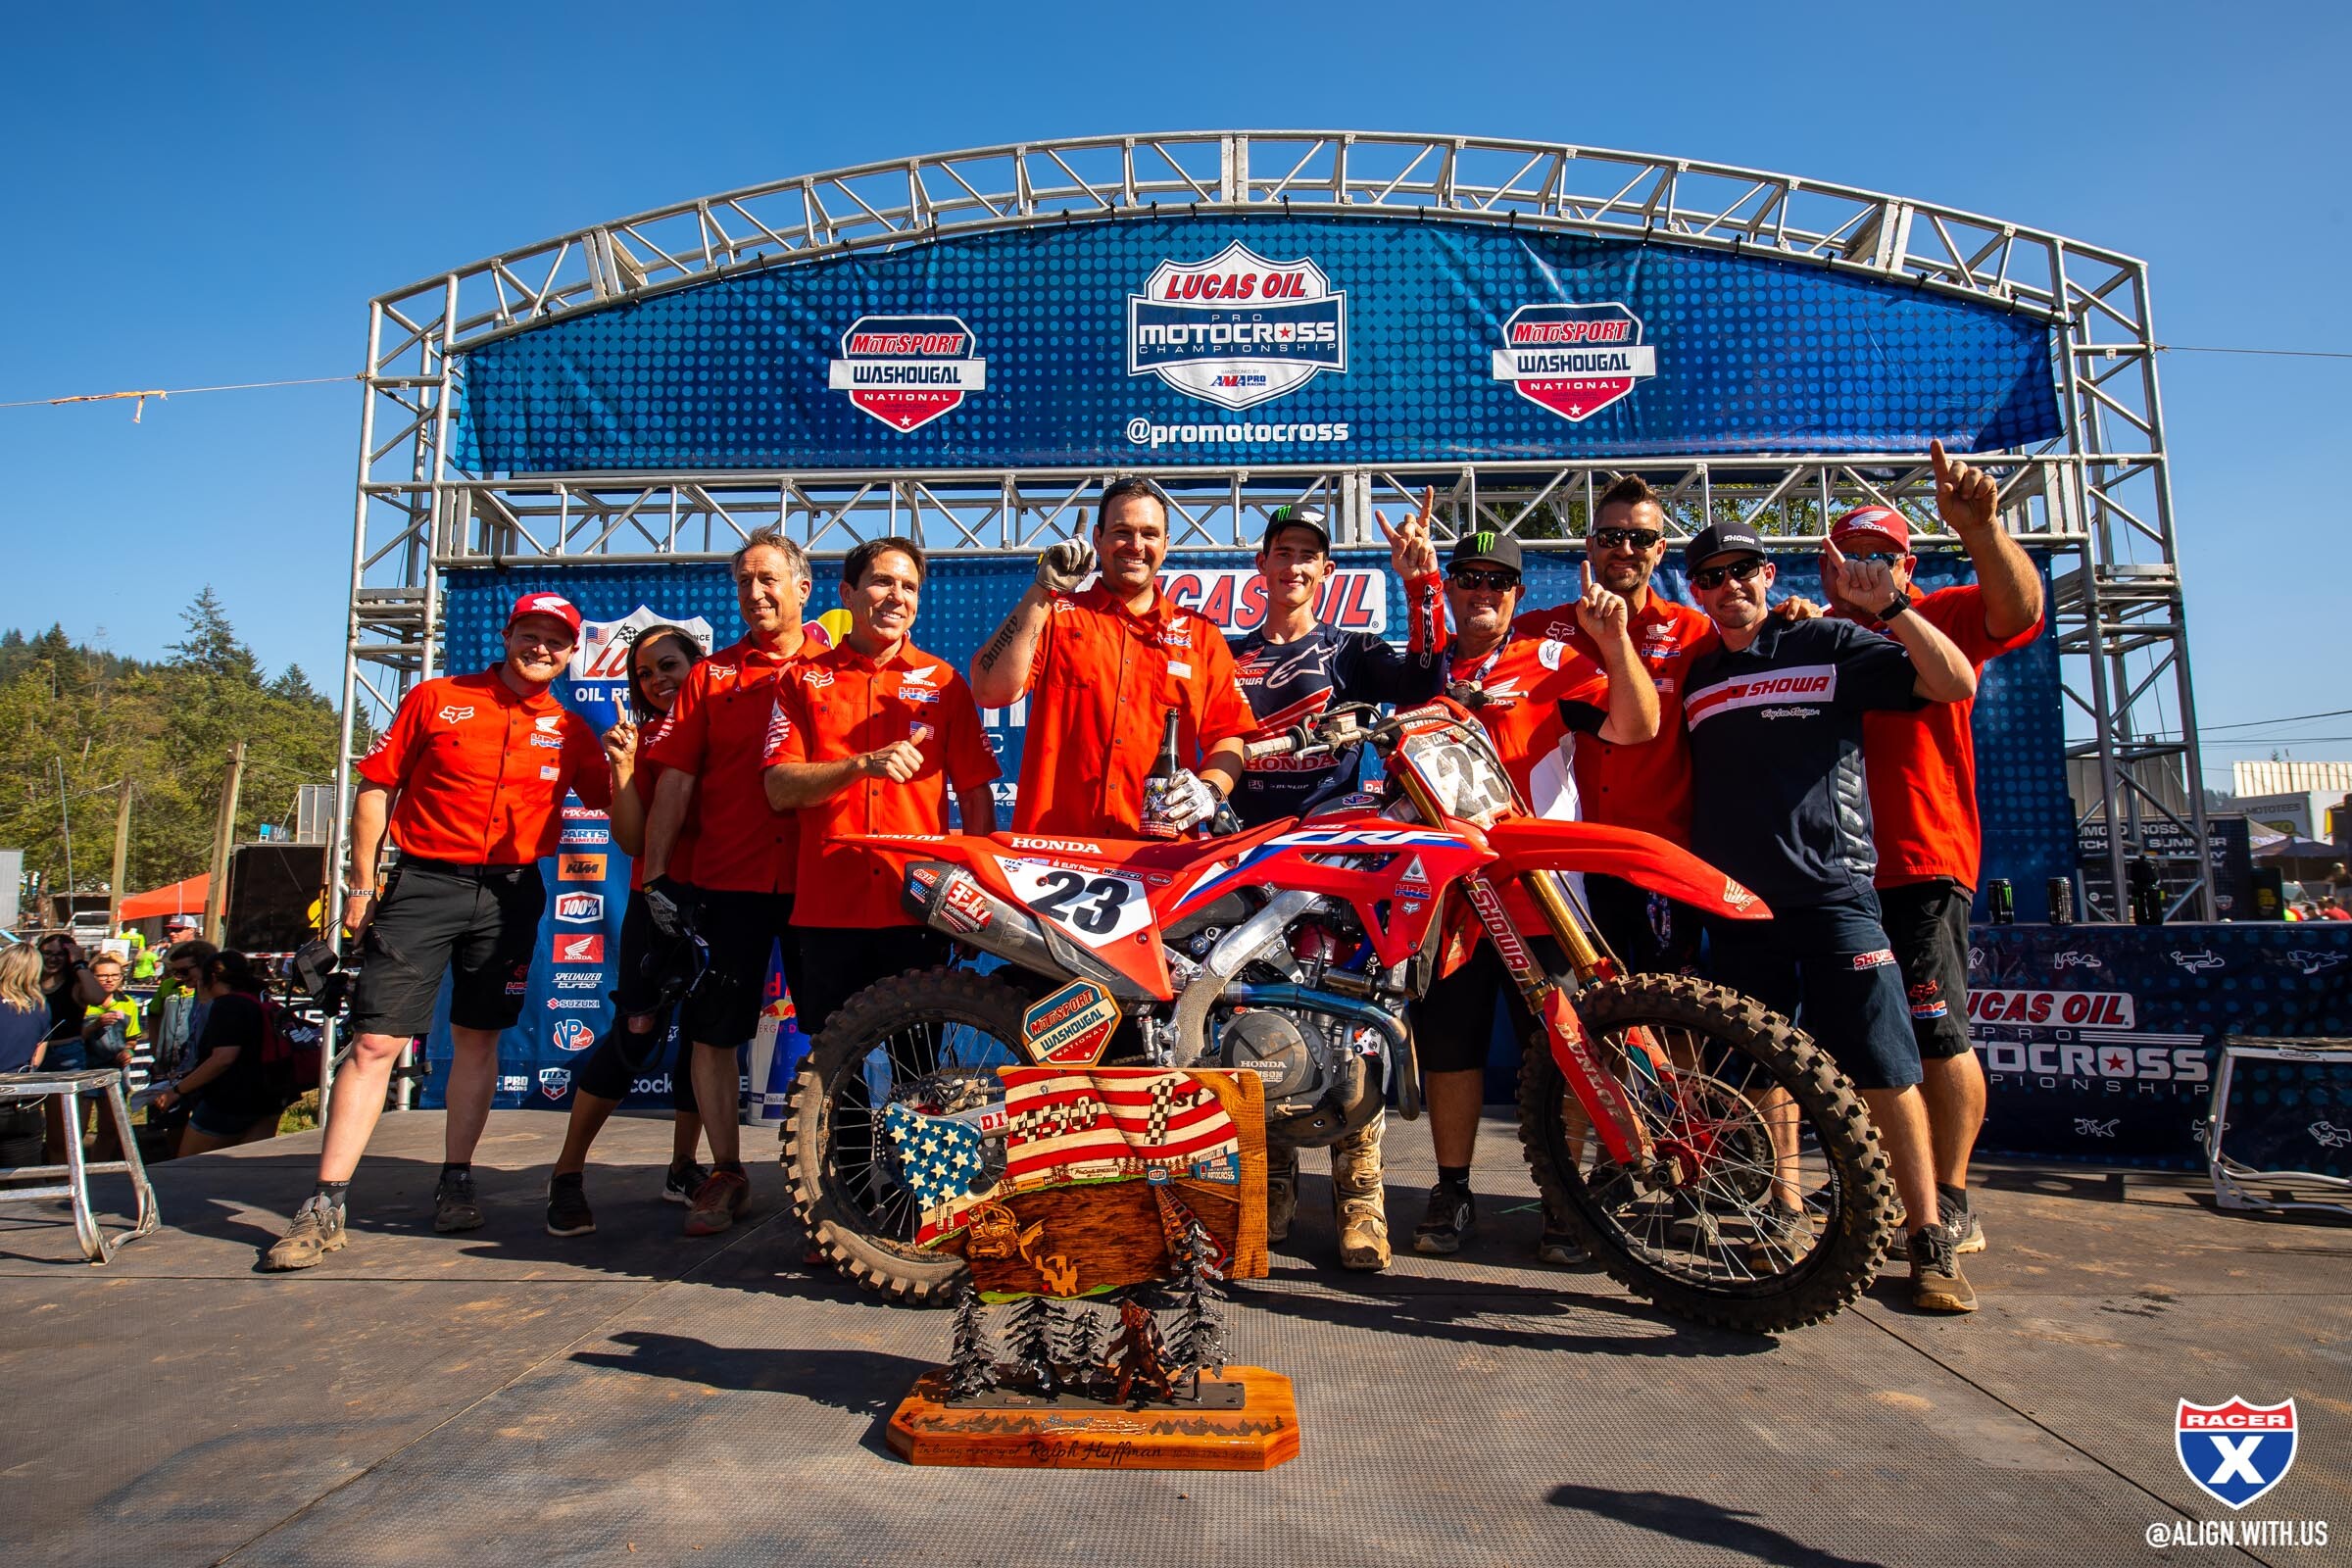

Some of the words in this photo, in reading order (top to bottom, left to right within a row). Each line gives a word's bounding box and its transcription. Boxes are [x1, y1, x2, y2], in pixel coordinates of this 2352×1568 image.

[1164, 273, 1256, 300] LUCAS
[1262, 272, 1308, 298] OIL
[1139, 321, 1336, 344] MOTOCROSS
[1139, 343, 1336, 354] CHAMPIONSHIP
[1518, 353, 1631, 372] WASHOUGAL
[854, 367, 961, 383] WASHOUGAL
[1209, 375, 1246, 387] AMA
[1530, 381, 1620, 391] NATIONAL
[1126, 417, 1349, 449] @promotocross
[1723, 534, 1755, 545] SHOWA
[1154, 574, 1268, 629] CAS
[980, 615, 1019, 674] Dungey
[1642, 643, 1681, 659] HRC
[1235, 677, 1263, 686] OWA
[1748, 676, 1830, 696] SHOWA
[575, 688, 605, 702] OIL
[899, 687, 940, 704] HRC
[1245, 755, 1341, 773] HONDA
[1011, 837, 1102, 855] HONDA
[1263, 830, 1466, 846] CRF
[565, 860, 600, 874] KTM
[1079, 864, 1100, 873] Power
[1396, 884, 1432, 900] HRC
[563, 899, 598, 915] 100%
[1027, 871, 1130, 934] 23
[1470, 888, 1531, 972] SHOWA
[560, 1000, 601, 1008] SUZUKI
[2062, 994, 2126, 1025] OIL
[759, 1024, 785, 1034] ERGY
[1040, 1008, 1105, 1052] WASHOUGAL
[1983, 1027, 2072, 1041] PRO
[1055, 1027, 1104, 1057] NATIONAL
[504, 1076, 529, 1086] PRO
[1990, 1074, 2210, 1096] PIONSHIP
[981, 1113, 1009, 1131] D.I.
[1012, 1097, 1099, 1143] 450
[918, 1444, 930, 1454] In
[932, 1444, 962, 1459] loving
[966, 1446, 1006, 1460] memory
[1008, 1445, 1021, 1457] of
[1027, 1441, 1079, 1468] Ralph
[1081, 1441, 1162, 1466] Huffman
